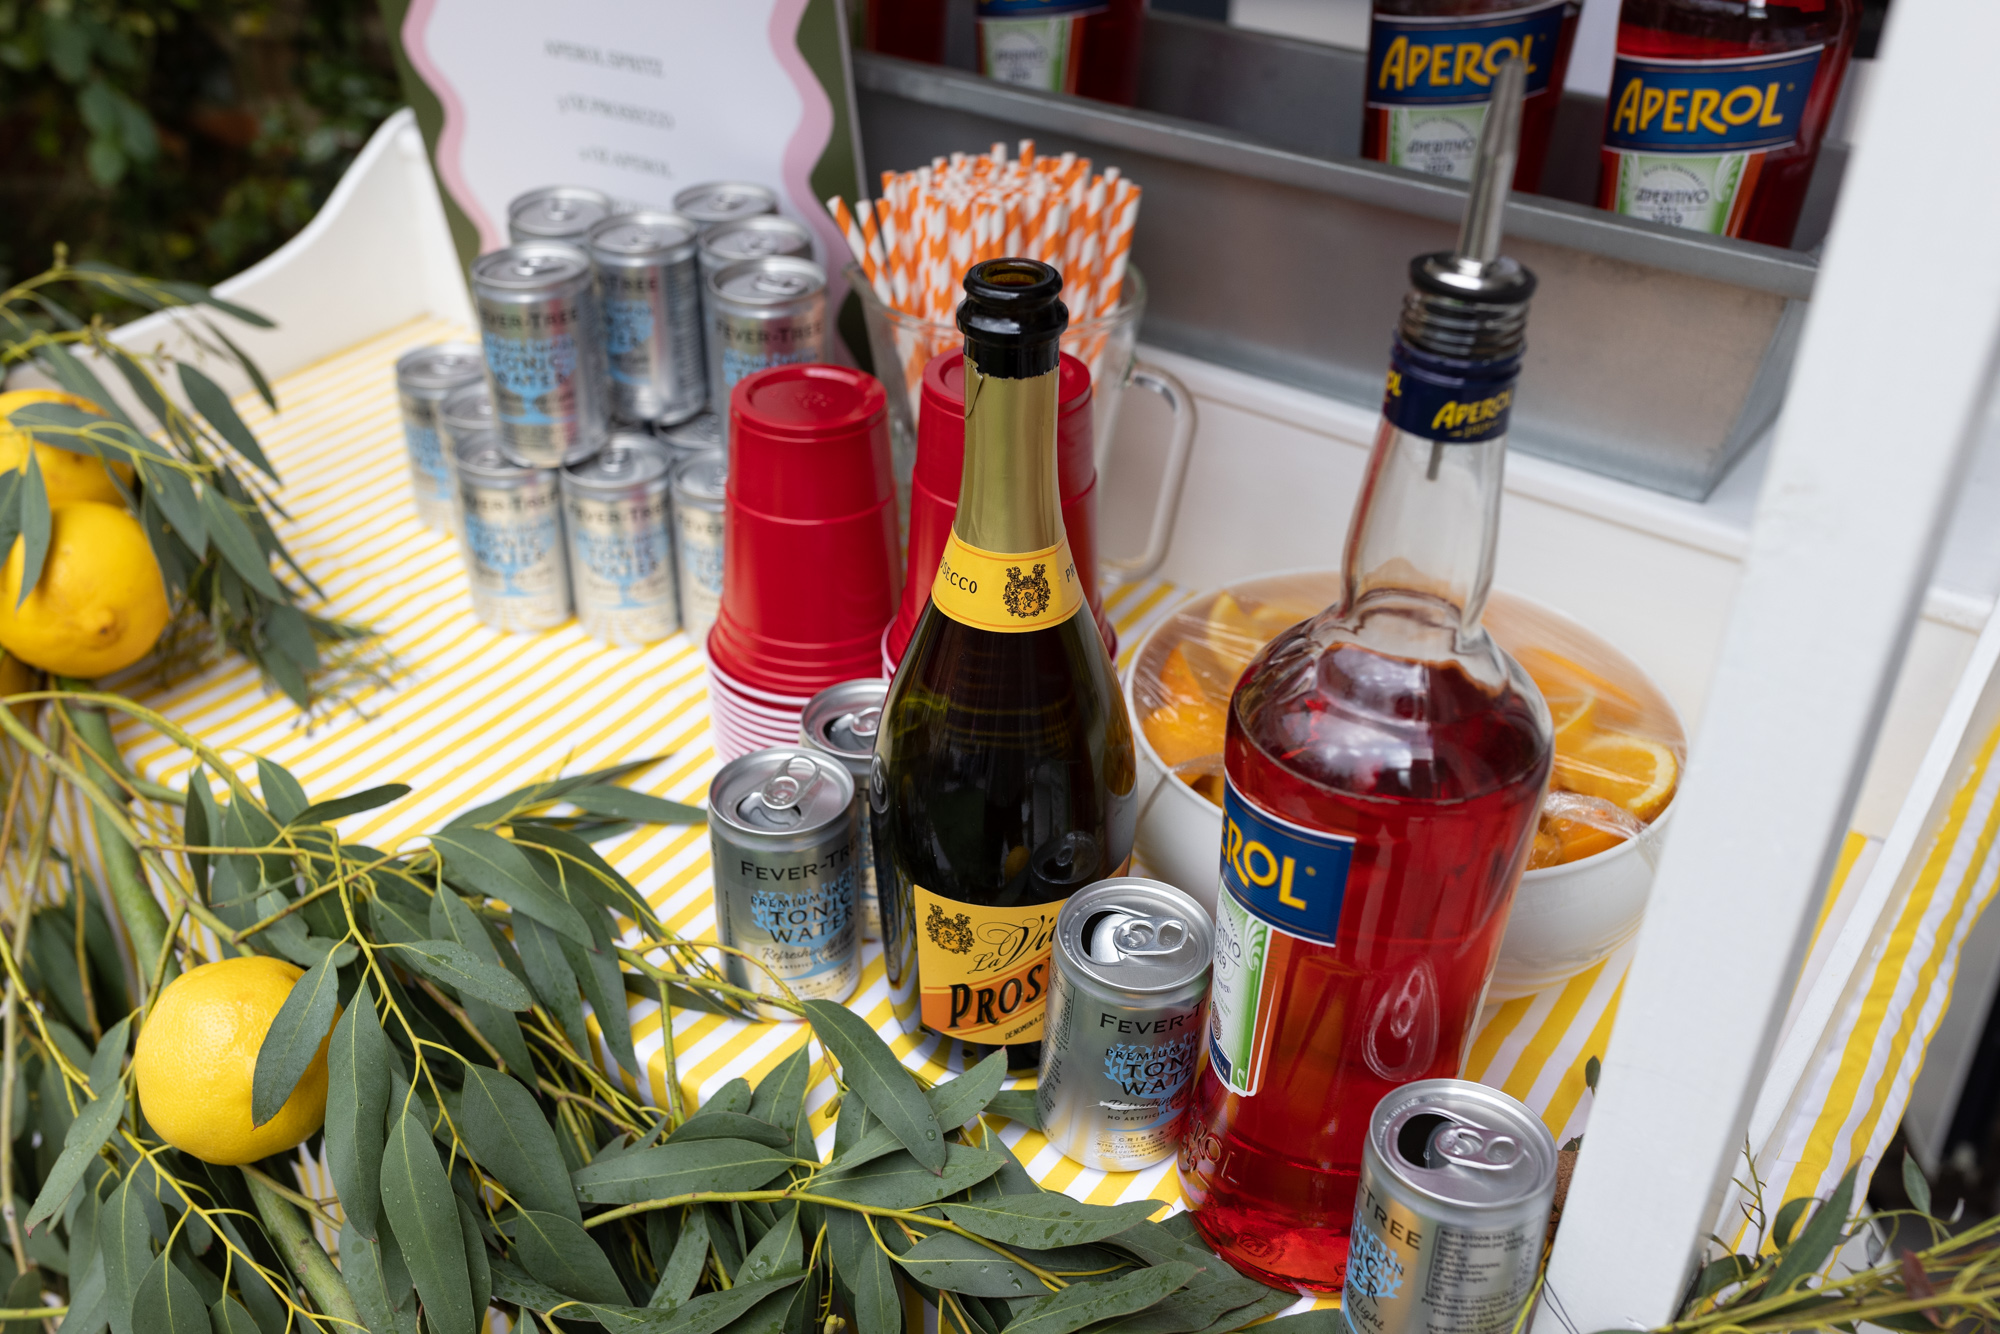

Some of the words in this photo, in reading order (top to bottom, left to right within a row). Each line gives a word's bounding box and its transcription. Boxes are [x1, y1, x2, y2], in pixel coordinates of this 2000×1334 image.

[1378, 34, 1537, 91] APEROL
[1612, 77, 1783, 135] APEROL
[751, 893, 821, 909] PREMIUM
[770, 888, 852, 926] TONIC
[967, 952, 1001, 974] La
[948, 957, 1050, 1029] PROS
[1100, 996, 1206, 1035] FEVER-T
[1105, 1043, 1181, 1062] PREMIUM
[1124, 1108, 1168, 1121] ARTIFICIAL
[1118, 1133, 1154, 1143] CRISP
[1356, 1298, 1384, 1331] Light
